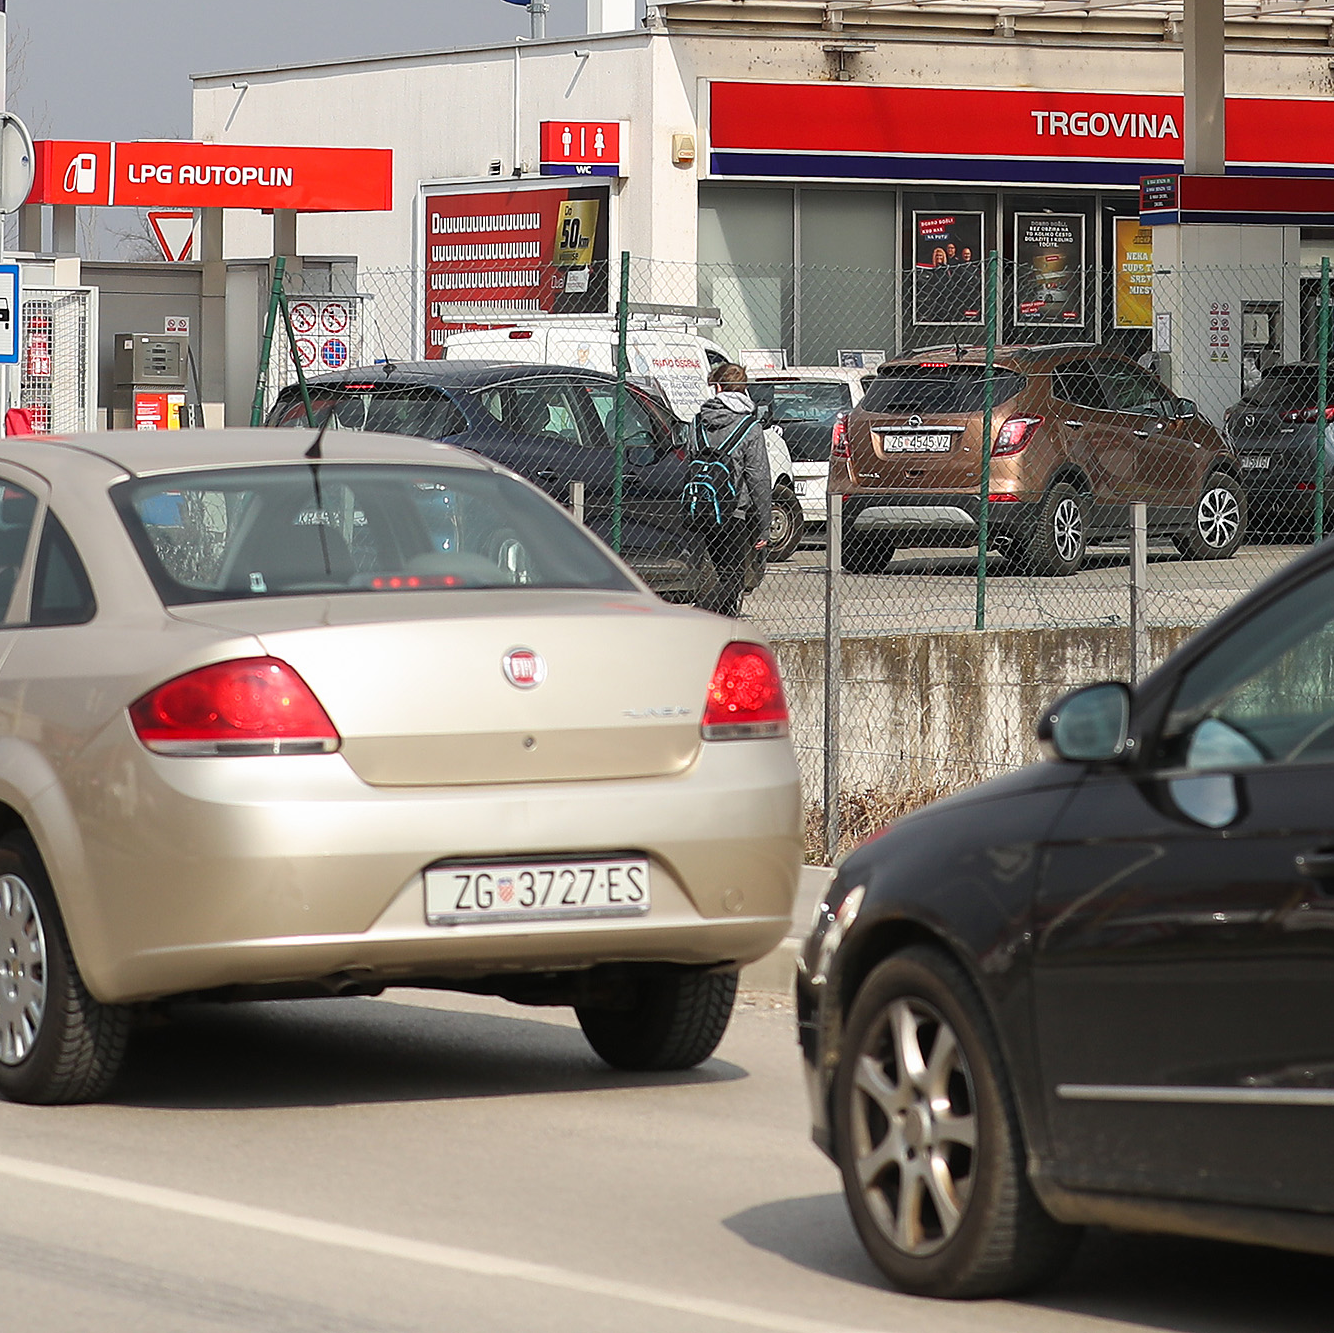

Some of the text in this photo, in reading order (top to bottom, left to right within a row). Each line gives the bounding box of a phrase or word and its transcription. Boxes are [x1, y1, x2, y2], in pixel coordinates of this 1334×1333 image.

[1030, 110, 1180, 139] TRGOVINA
[128, 164, 293, 187] LPG AUTOPLIN
[575, 165, 593, 175] WC
[560, 218, 590, 250] 50 km
[453, 873, 494, 910] ZG
